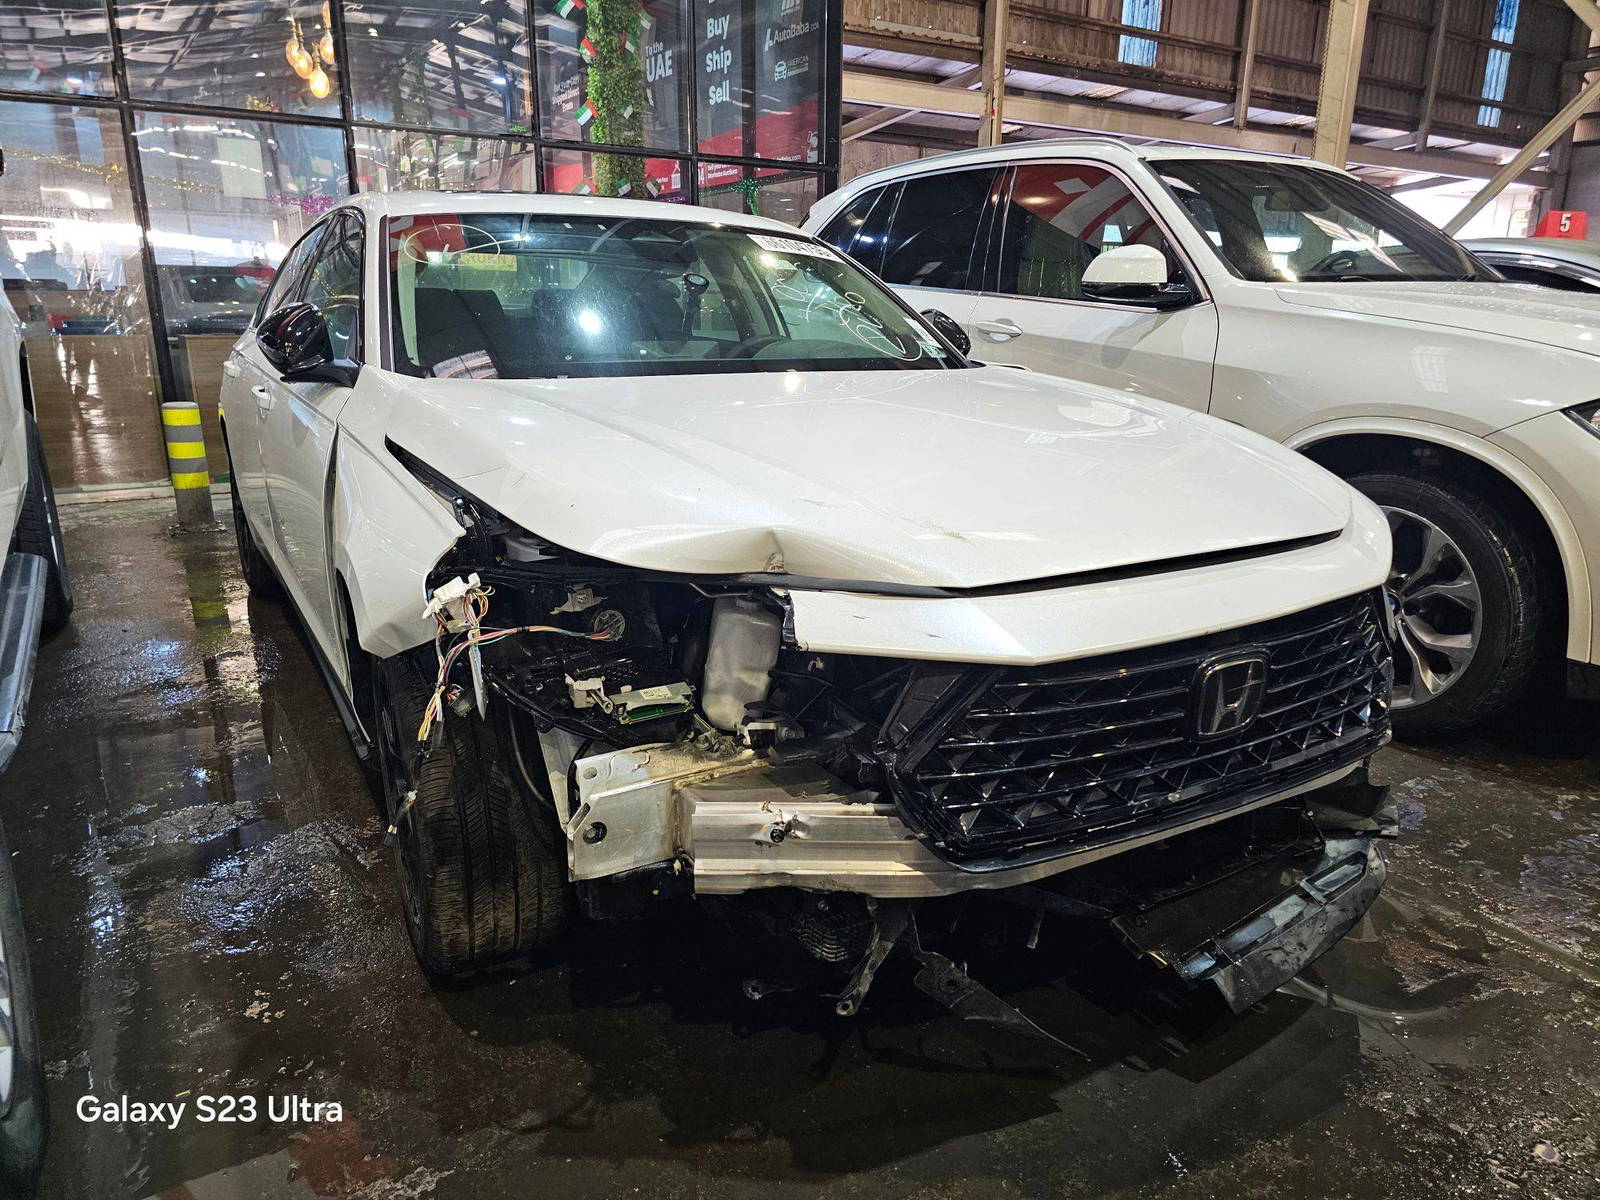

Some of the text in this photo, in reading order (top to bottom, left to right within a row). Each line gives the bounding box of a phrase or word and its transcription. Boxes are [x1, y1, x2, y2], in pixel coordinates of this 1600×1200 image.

[707, 14, 730, 40] Buy
[646, 49, 673, 82] UAE
[706, 45, 732, 74] Ship
[709, 80, 730, 105] Sell
[1559, 213, 1572, 233] 5
